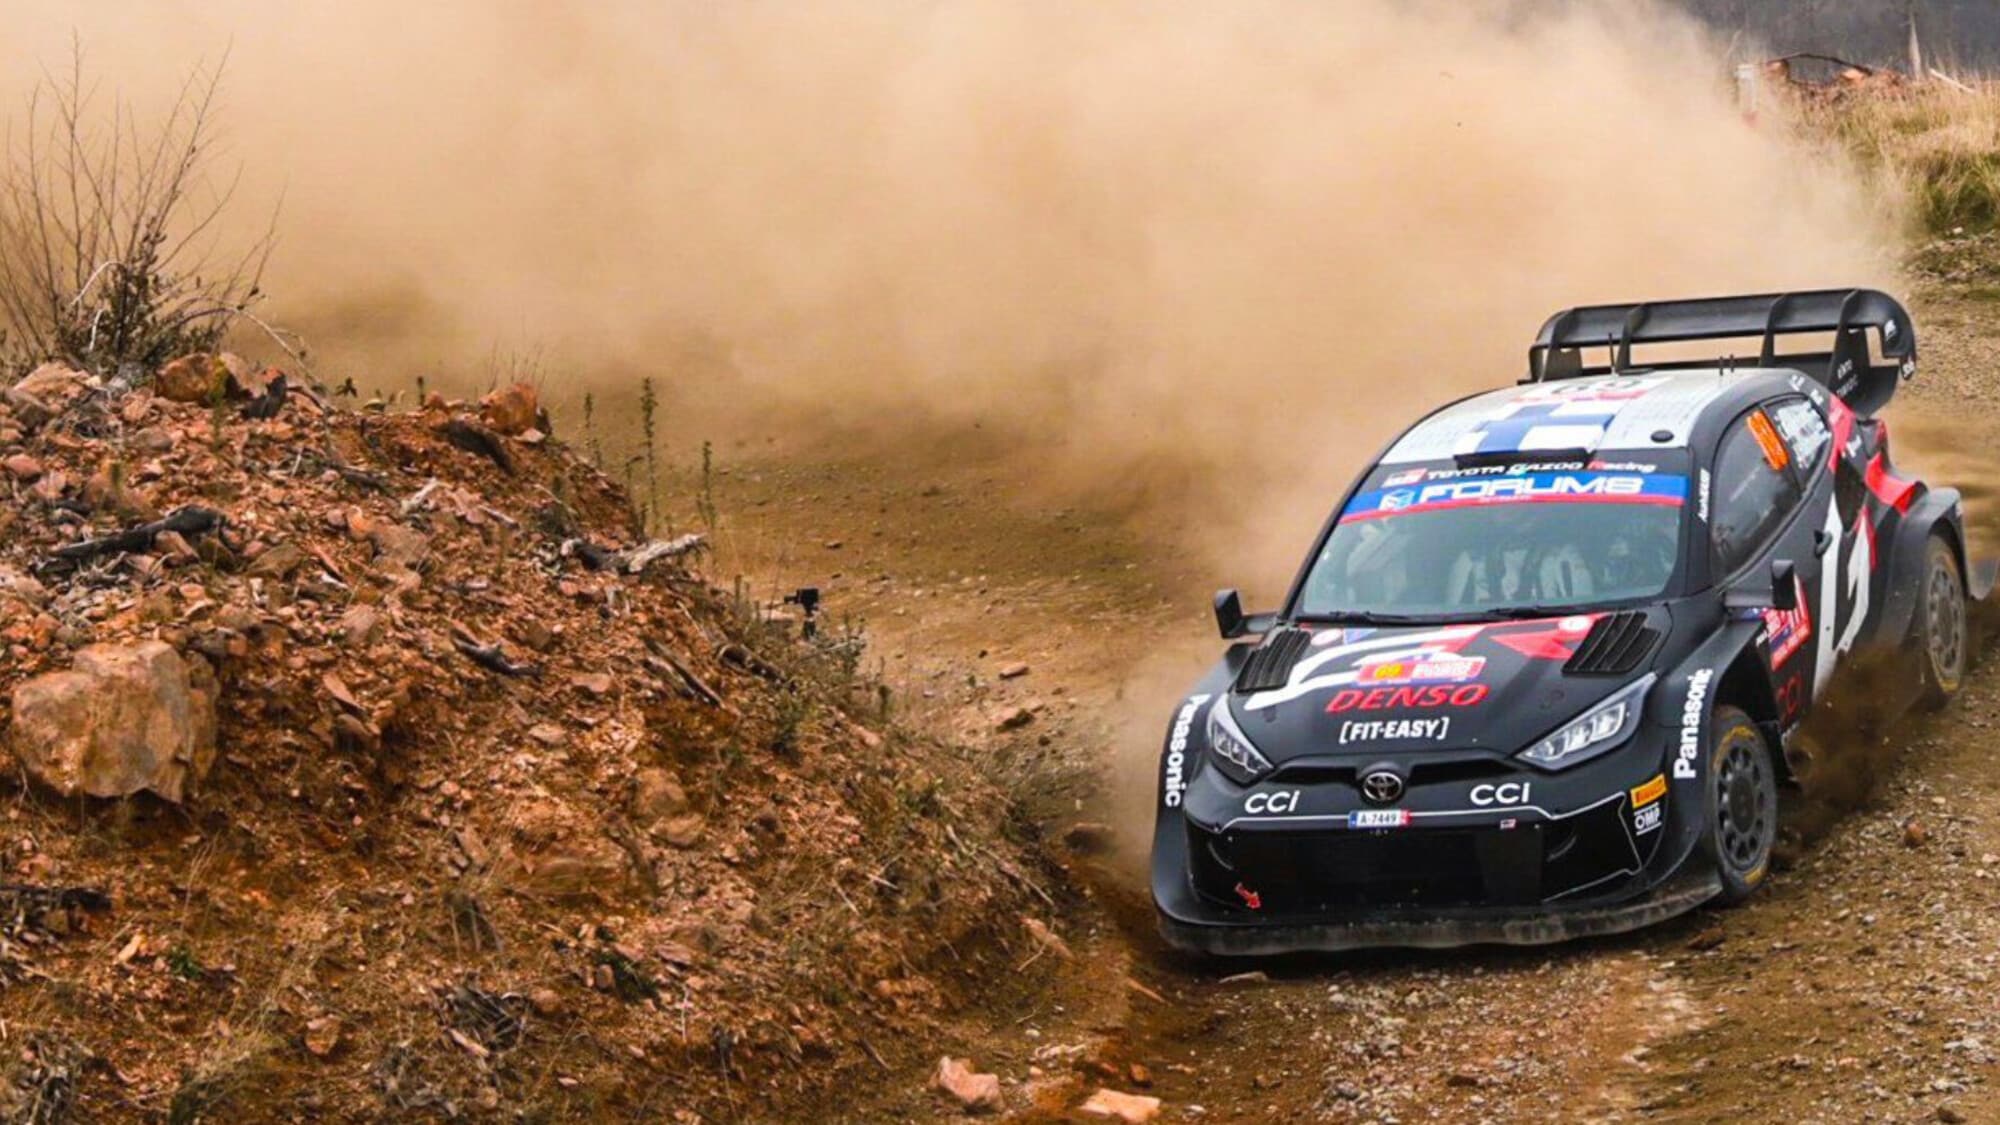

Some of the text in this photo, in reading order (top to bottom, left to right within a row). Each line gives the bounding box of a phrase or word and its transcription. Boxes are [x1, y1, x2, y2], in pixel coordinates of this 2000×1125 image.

[1419, 476, 1644, 505] FORUM8
[1325, 684, 1490, 713] DENSO
[1673, 667, 1714, 779] Panasonic
[1244, 790, 1300, 814] CCI
[1470, 782, 1530, 806] CCI
